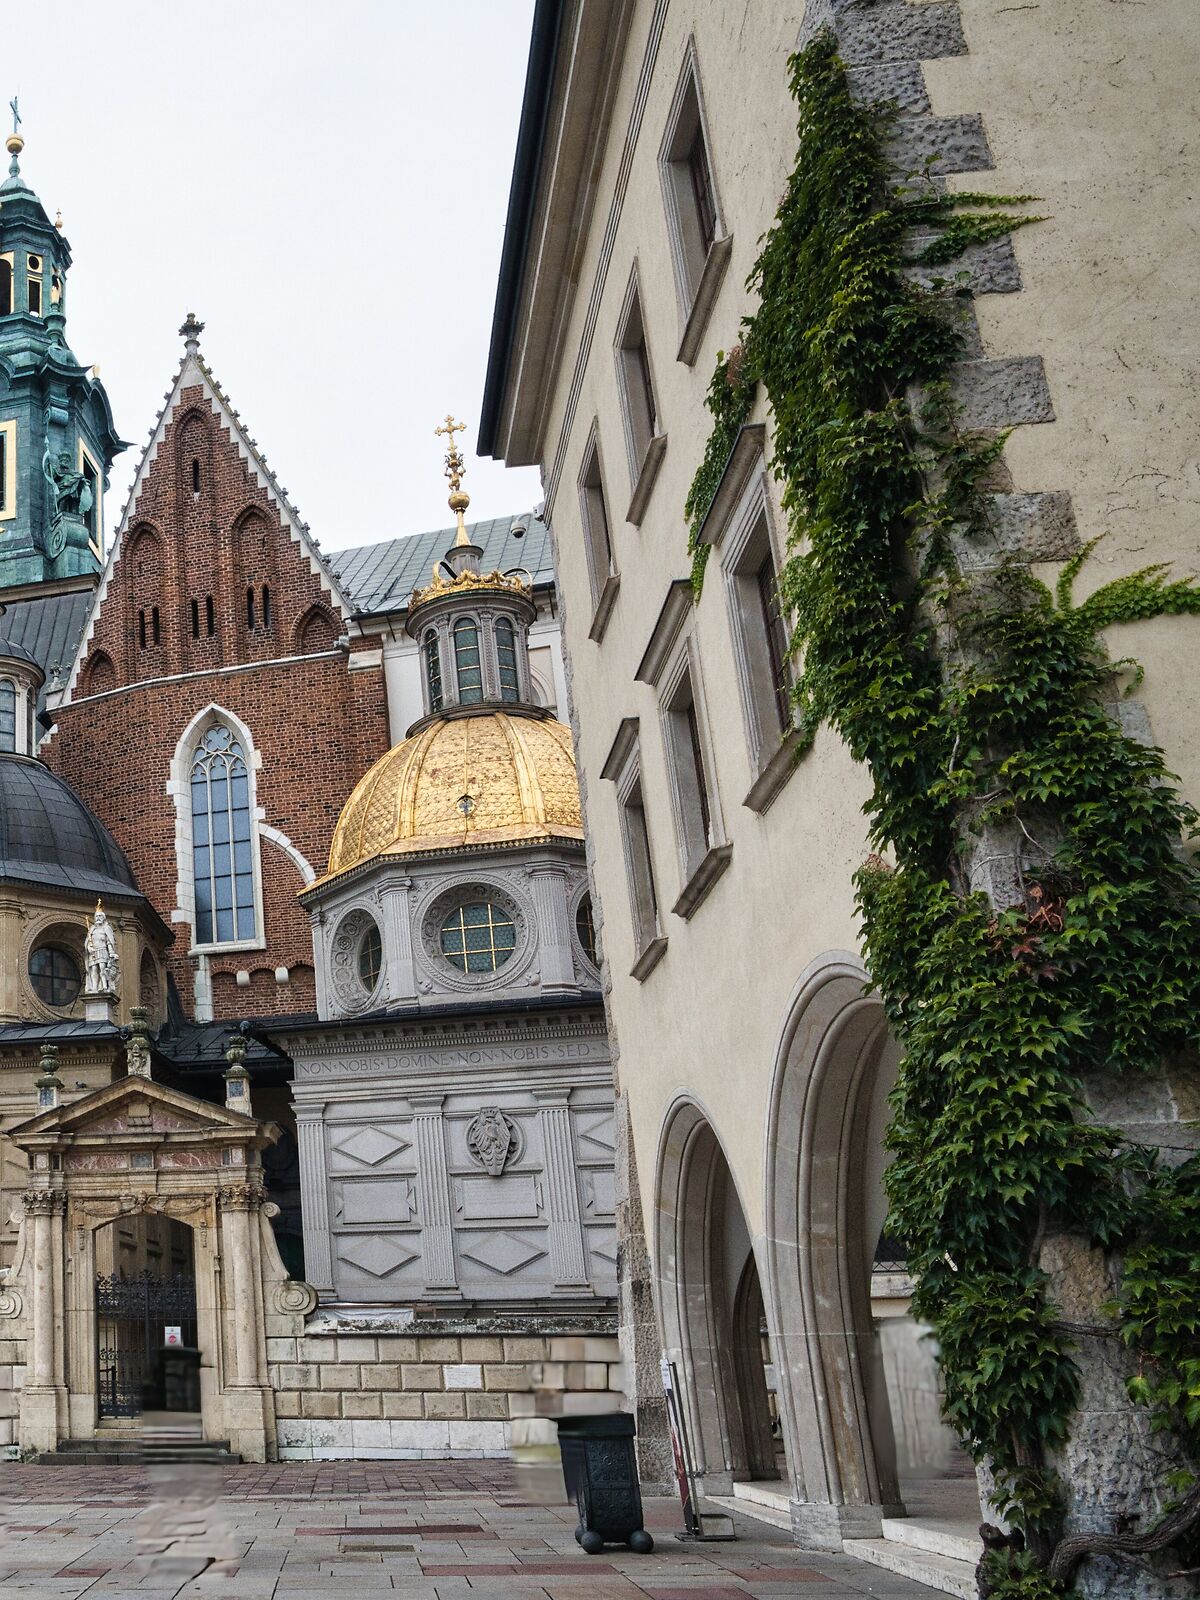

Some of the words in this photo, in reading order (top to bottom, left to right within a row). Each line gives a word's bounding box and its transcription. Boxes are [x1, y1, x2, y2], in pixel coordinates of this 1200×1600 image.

[299, 1062, 333, 1075] NON
[338, 1058, 382, 1073] NOBIS
[386, 1053, 450, 1070] DOMINE
[457, 1050, 495, 1064] NON
[501, 1045, 549, 1061] NOBIS
[557, 1043, 590, 1058] SED
